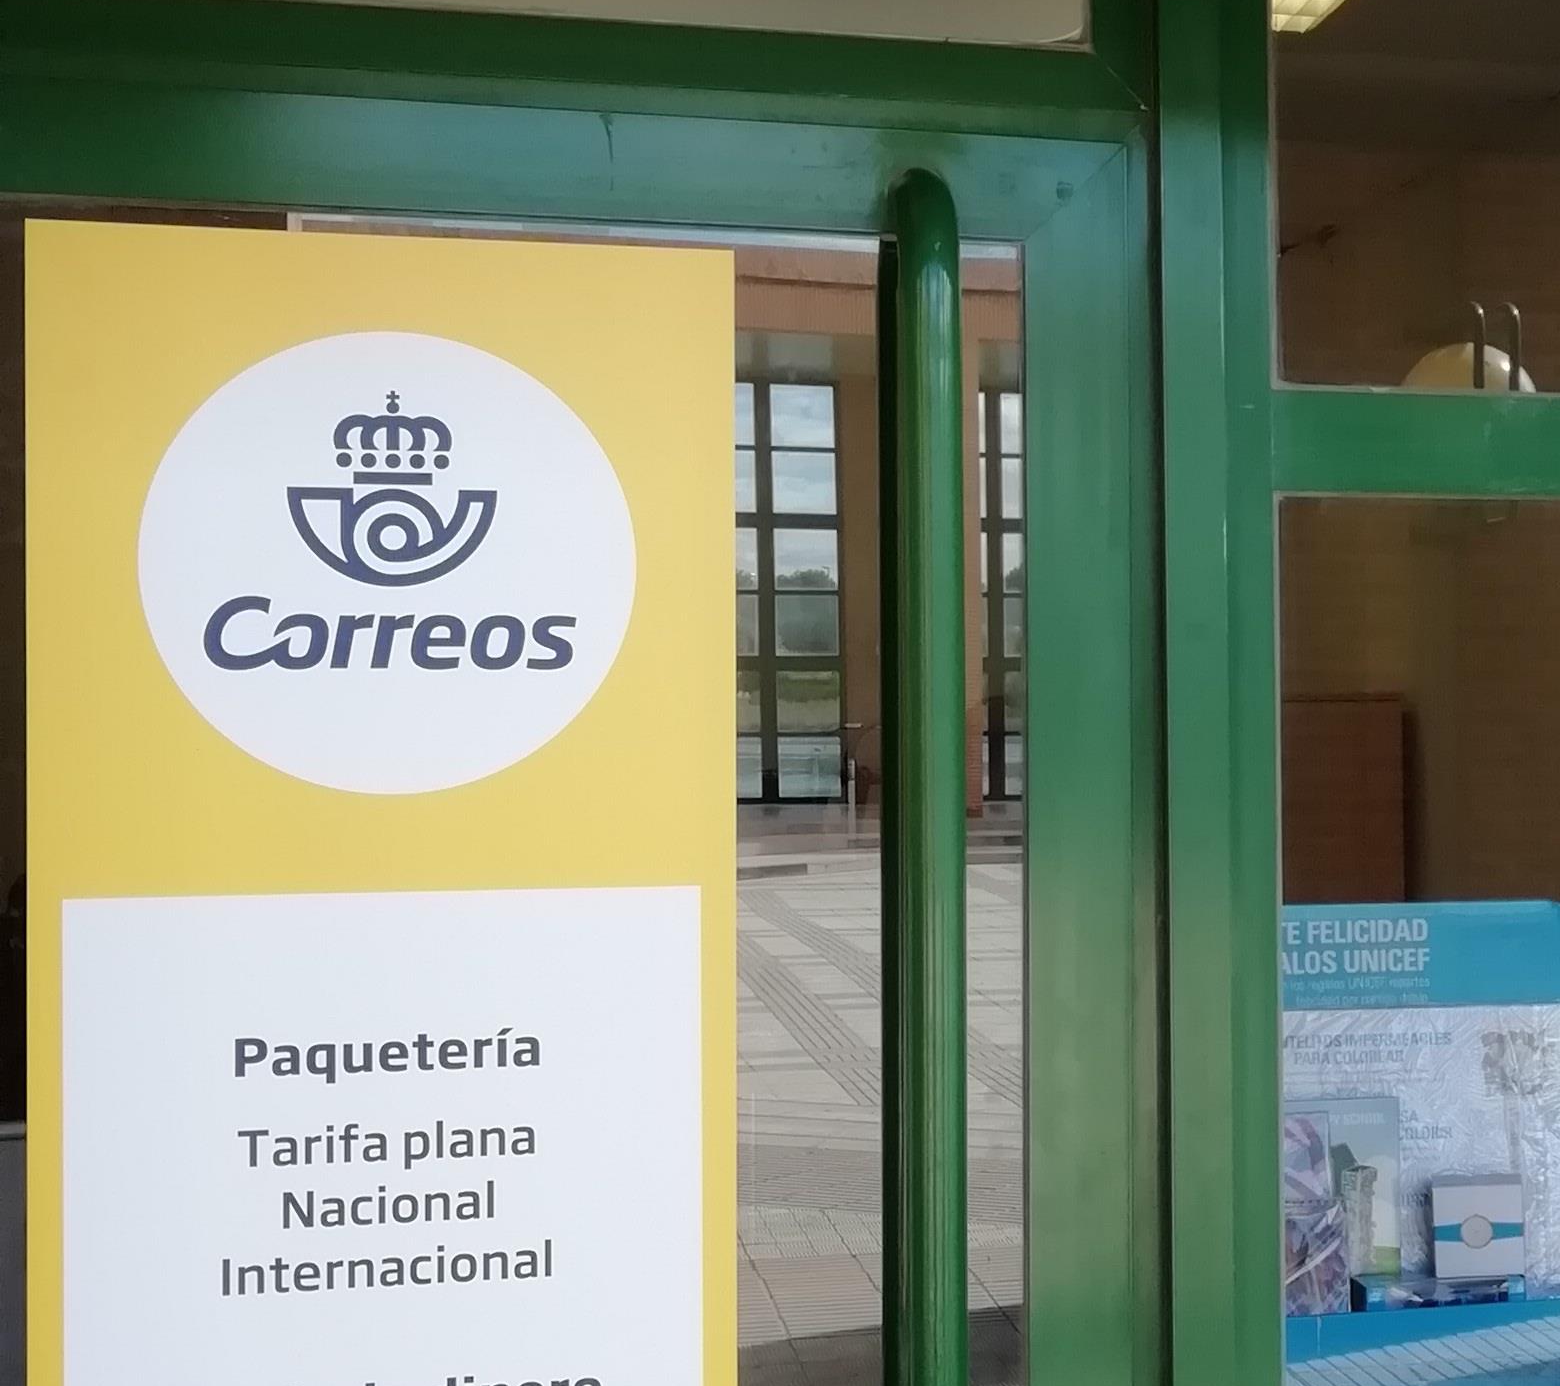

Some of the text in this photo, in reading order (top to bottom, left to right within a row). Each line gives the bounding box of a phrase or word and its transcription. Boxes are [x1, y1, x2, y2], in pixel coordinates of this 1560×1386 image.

[203, 595, 578, 671] Correos
[1306, 917, 1430, 945] FELICIDAD
[1343, 947, 1431, 974] UNICEF
[233, 1027, 542, 1084] Paquetería
[1294, 1050, 1331, 1066] PARA
[237, 1120, 537, 1170] Tarifa plana
[281, 1180, 496, 1229] Nacional
[220, 1239, 554, 1297] Internacional
